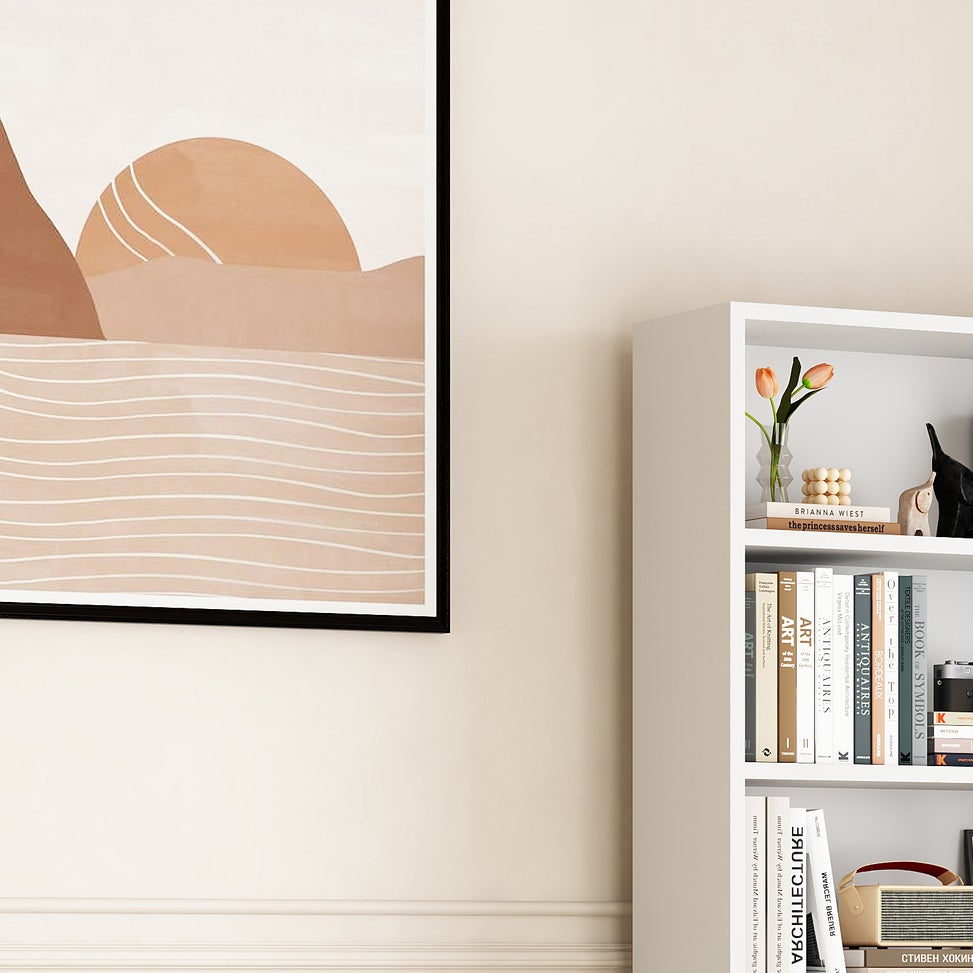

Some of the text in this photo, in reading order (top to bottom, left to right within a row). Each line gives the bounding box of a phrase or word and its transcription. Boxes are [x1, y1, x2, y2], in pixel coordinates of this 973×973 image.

[788, 520, 802, 529] the
[802, 522, 836, 531] princess
[857, 524, 885, 533] herself
[794, 508, 834, 516] BRIANNA
[782, 616, 794, 646] ART
[800, 617, 812, 647] ART
[915, 621, 925, 658] BOOK
[820, 617, 831, 714] ANTIQUAIRES
[860, 623, 870, 716] ANTIQUAIRES
[874, 651, 883, 700] BORDEAUX
[914, 673, 925, 740] SYMBOLS
[901, 953, 940, 963] СТИВЕН
